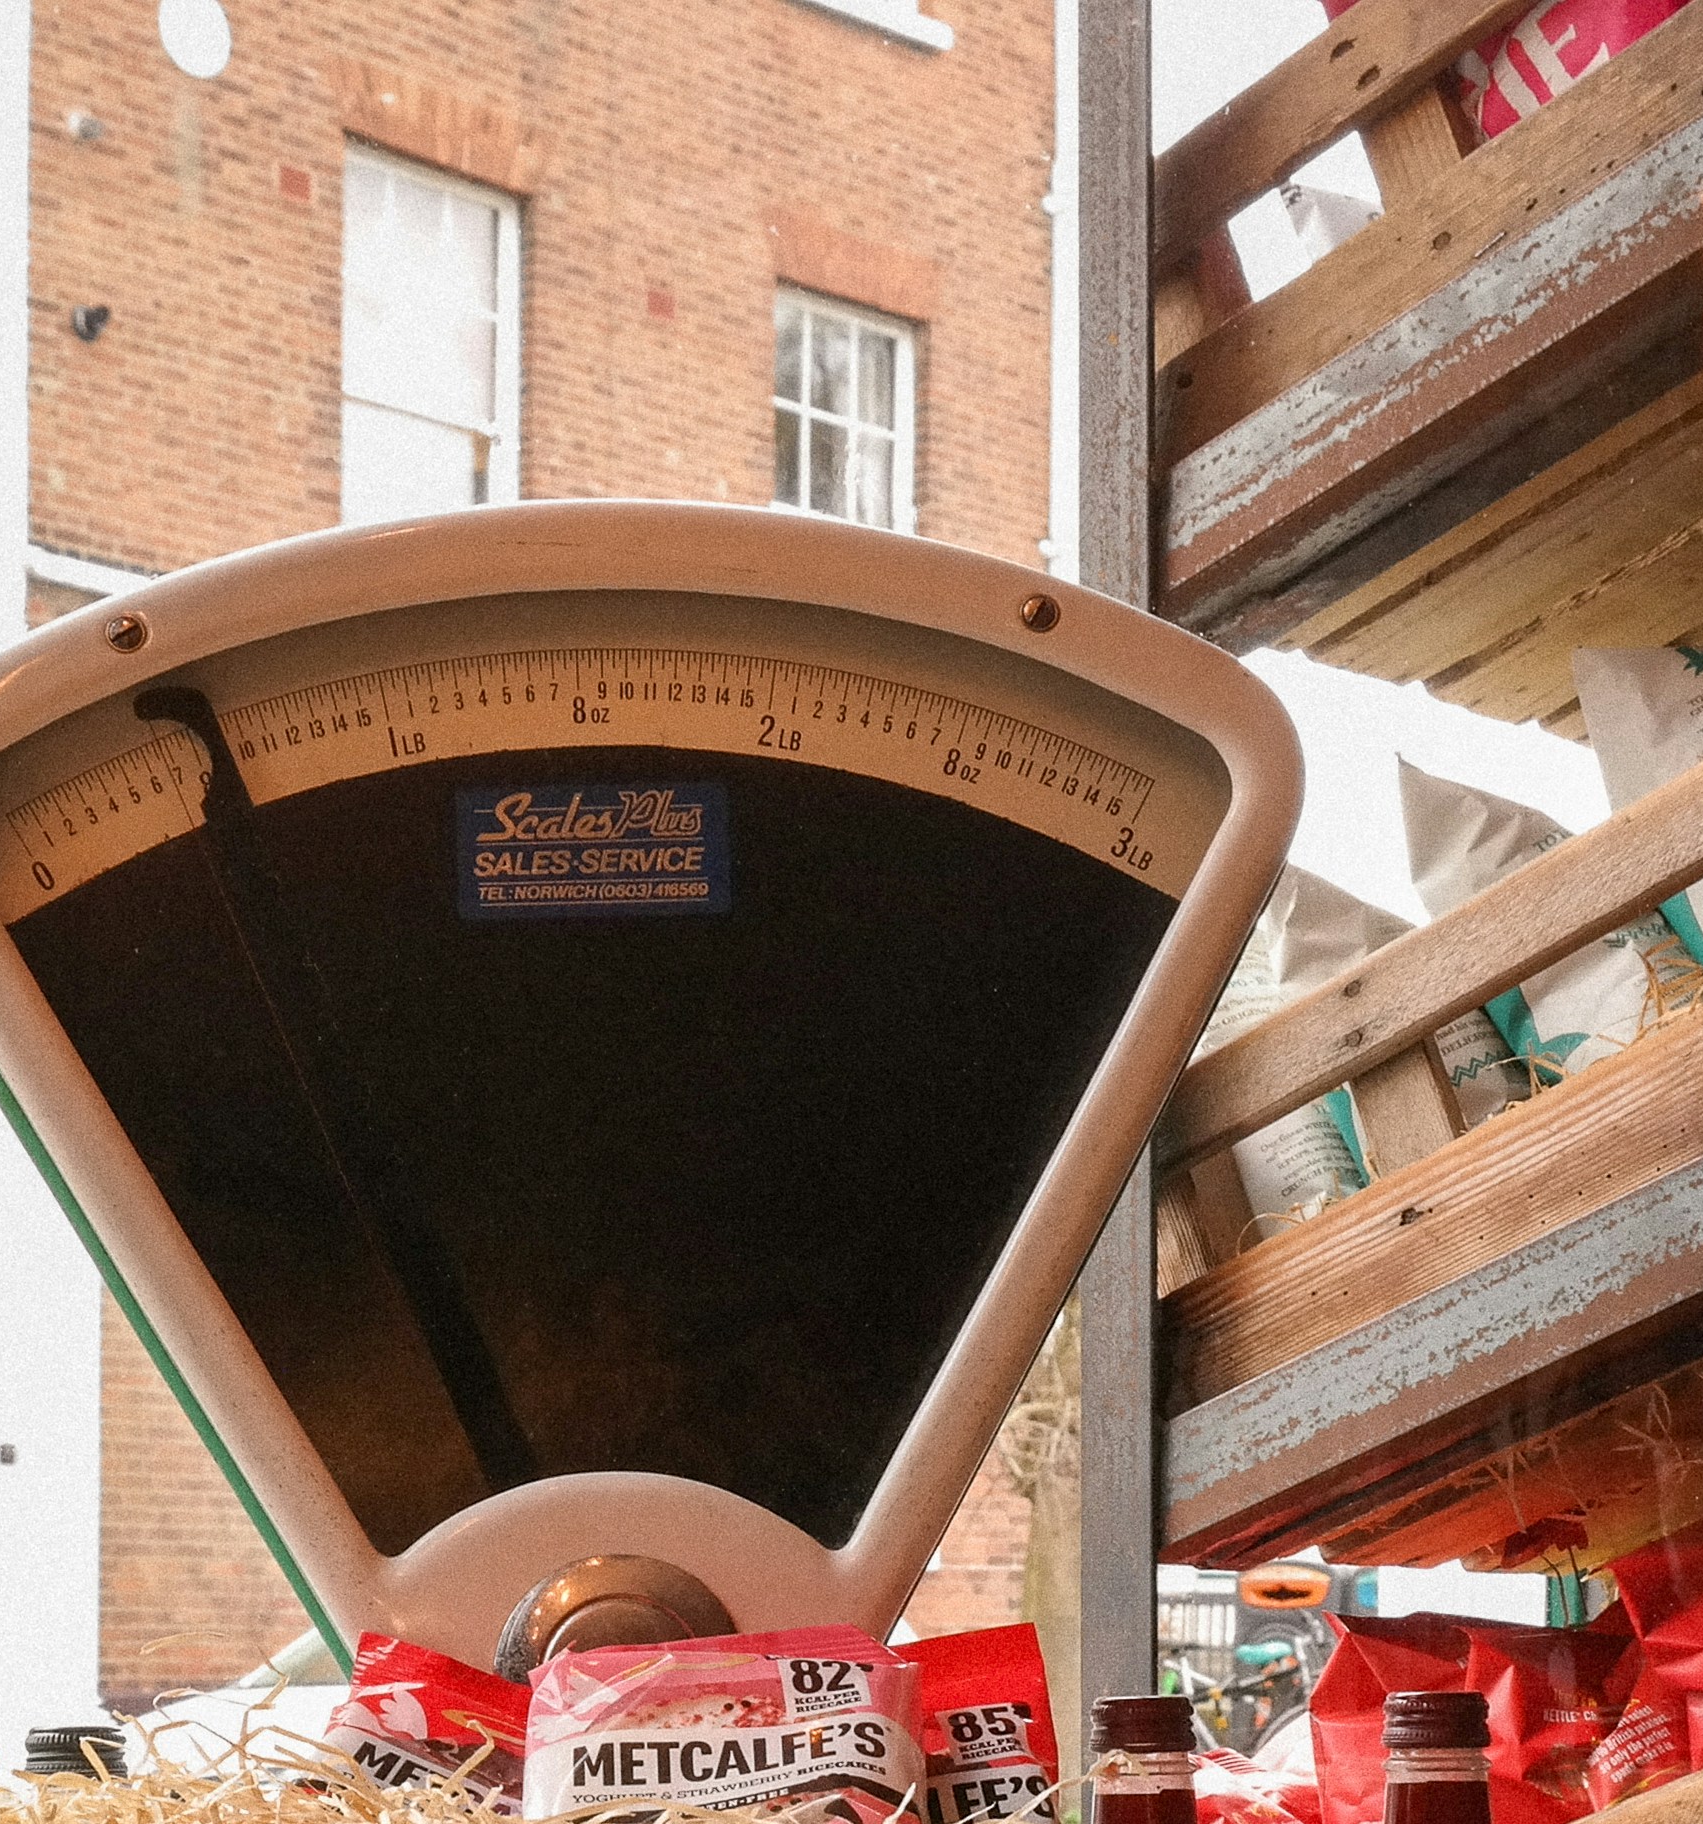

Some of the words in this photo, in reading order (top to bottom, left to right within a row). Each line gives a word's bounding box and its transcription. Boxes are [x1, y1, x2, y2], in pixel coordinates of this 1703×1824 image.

[408, 700, 414, 718] 1
[429, 696, 439, 714] 2
[454, 692, 464, 710] 3
[478, 689, 488, 707] 4
[502, 686, 512, 705] 5
[526, 684, 535, 702] 6
[549, 683, 559, 701] 7
[573, 696, 586, 724] 8
[597, 681, 607, 699] 9
[619, 682, 634, 700] 10
[644, 683, 656, 700] 11
[668, 683, 683, 702] 12
[692, 685, 706, 703] 13
[716, 687, 730, 706] 14
[740, 689, 754, 708] 15
[239, 741, 256, 761] 10
[262, 734, 278, 754] 11
[285, 727, 302, 747] 12
[309, 720, 326, 739] 13
[332, 714, 348, 733] 14
[356, 708, 371, 727] 15
[758, 715, 775, 746] 2
[778, 729, 801, 751] LB
[791, 696, 797, 714] 1
[813, 701, 824, 720] 2
[837, 705, 847, 723] 3
[860, 710, 870, 728] 4
[883, 715, 893, 733] 5
[906, 721, 917, 740] 6
[930, 728, 941, 746] 7
[388, 727, 398, 757] 1
[402, 732, 426, 755] LB
[943, 748, 960, 776] 8
[975, 743, 987, 760] 9
[995, 750, 1012, 769] 10
[1017, 758, 1034, 777] 11
[1038, 766, 1058, 788] 12
[1061, 776, 1079, 796] 13
[1083, 785, 1100, 806] 14
[1105, 795, 1124, 816] 15
[43, 831, 54, 848] 1
[63, 818, 77, 836] 2
[85, 808, 98, 825] 3
[108, 797, 120, 813] 4
[128, 786, 141, 804] 5
[151, 776, 163, 794] 6
[173, 767, 184, 785] 7
[476, 791, 614, 842] Scales
[610, 789, 703, 840] Plus
[1111, 827, 1134, 858] 3
[1127, 845, 1153, 871] LB
[31, 861, 55, 890] 0
[794, 1695, 832, 1706] KCAL
[833, 1690, 860, 1700] PER
[796, 1697, 862, 1714] RICECAKE
[573, 1721, 888, 1788] METCALFE'S
[958, 1742, 996, 1754] KCAL
[661, 1791, 672, 1801] &
[672, 1771, 794, 1799] STRAWBERRY
[797, 1760, 887, 1777] RICECAKES
